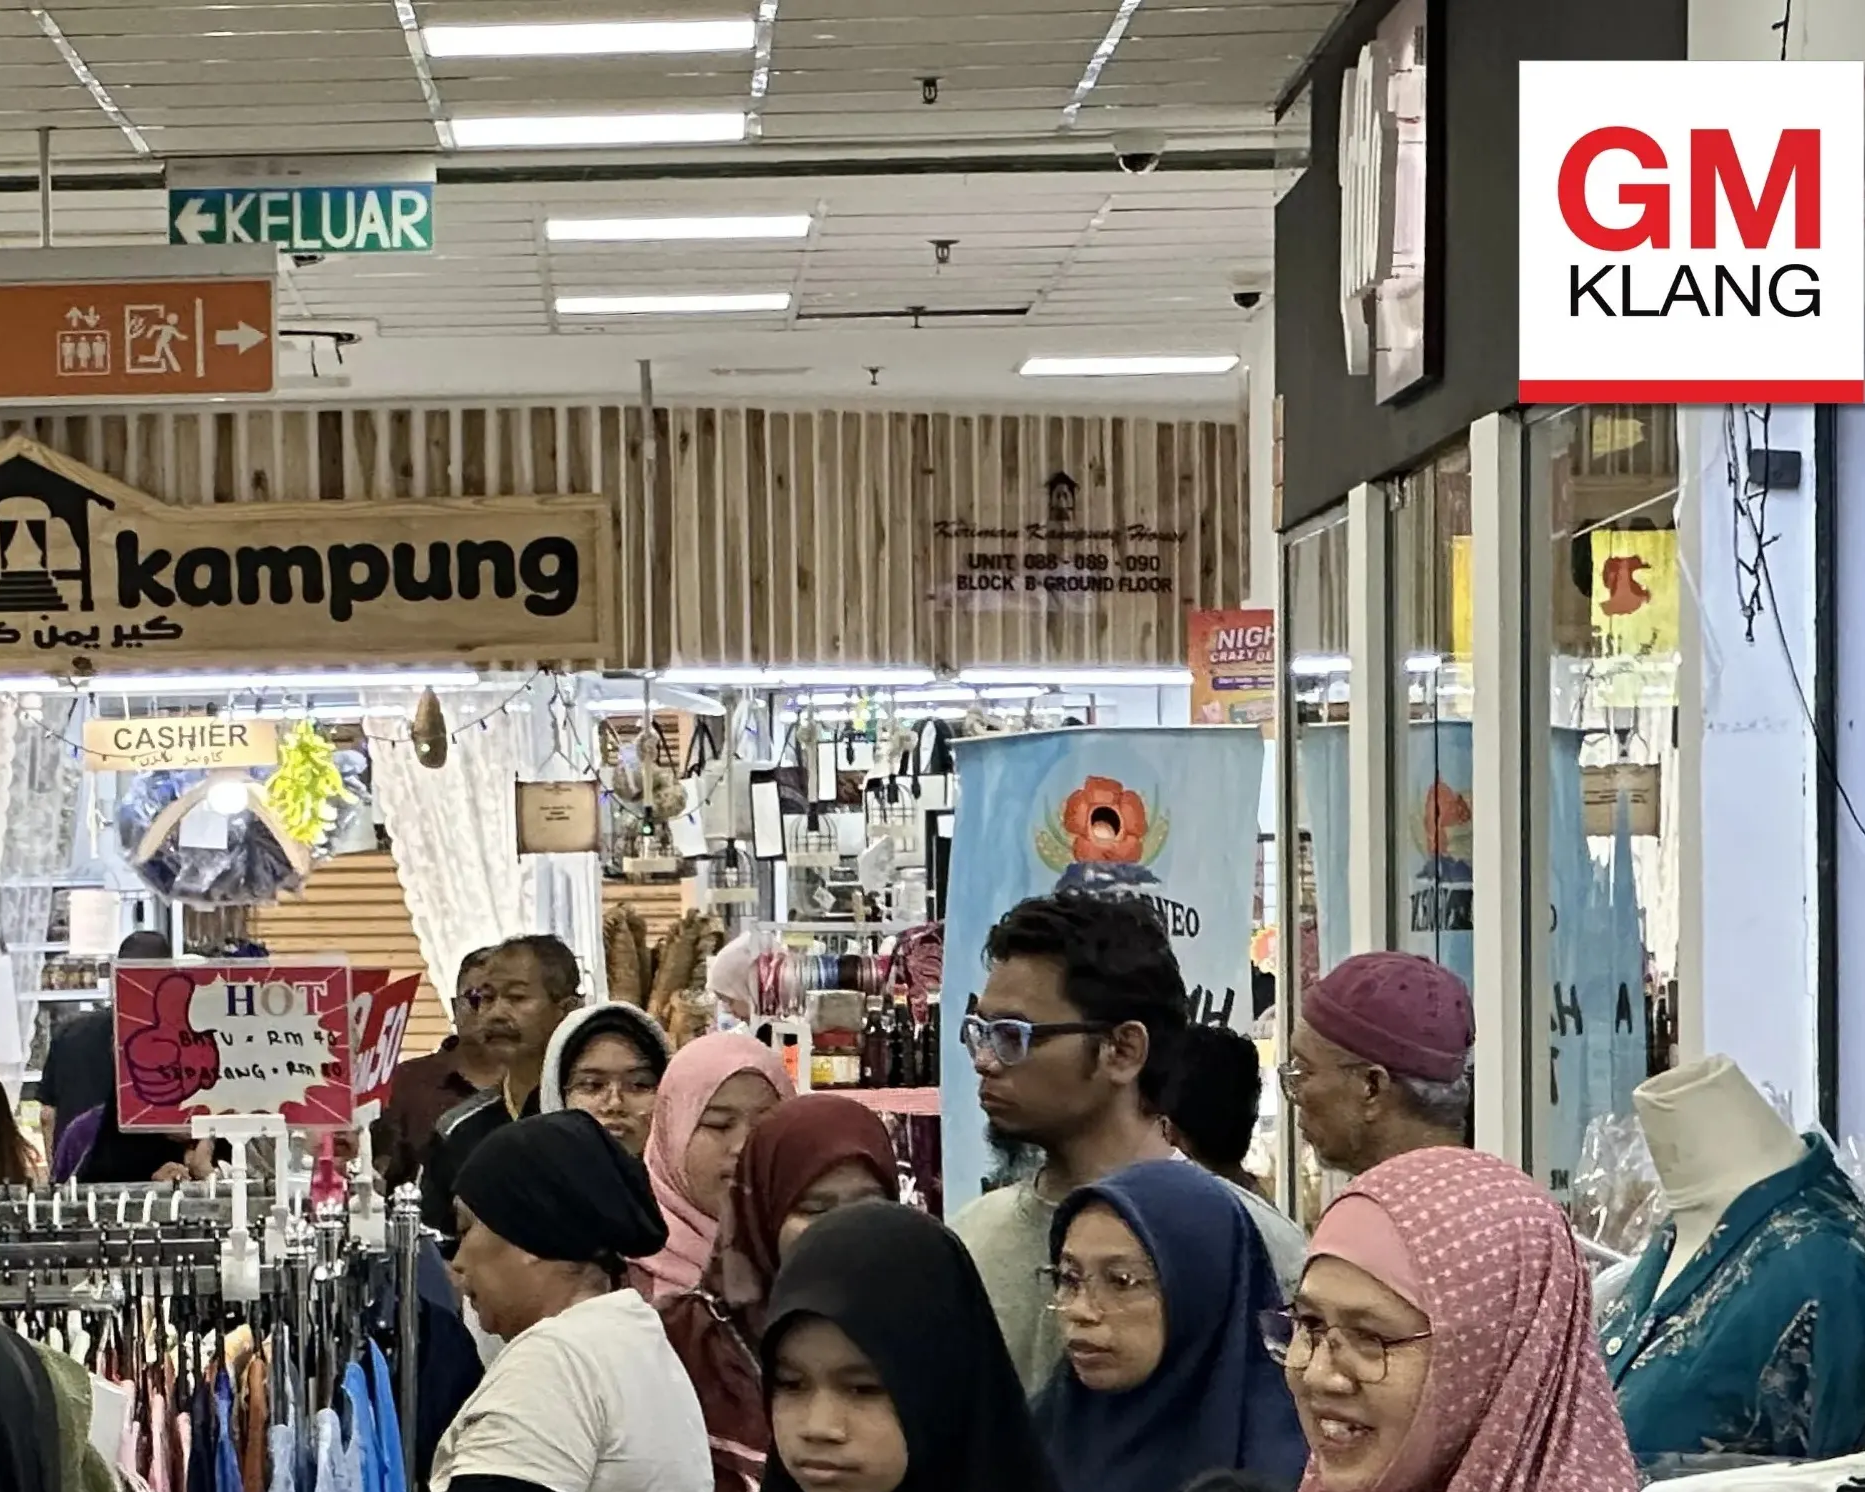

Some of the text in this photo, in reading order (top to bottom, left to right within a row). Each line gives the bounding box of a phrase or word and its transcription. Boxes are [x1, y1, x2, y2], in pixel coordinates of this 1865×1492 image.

[225, 190, 428, 249] KELUAR
[115, 529, 580, 623] kampung
[967, 553, 1016, 571] UNIT
[1126, 555, 1161, 571] 090
[956, 574, 1016, 591] BLOCK
[1118, 577, 1173, 593] FLOOR
[1218, 626, 1275, 650] NIGH
[113, 723, 250, 751] CASHIER
[225, 982, 328, 1017] HOT
